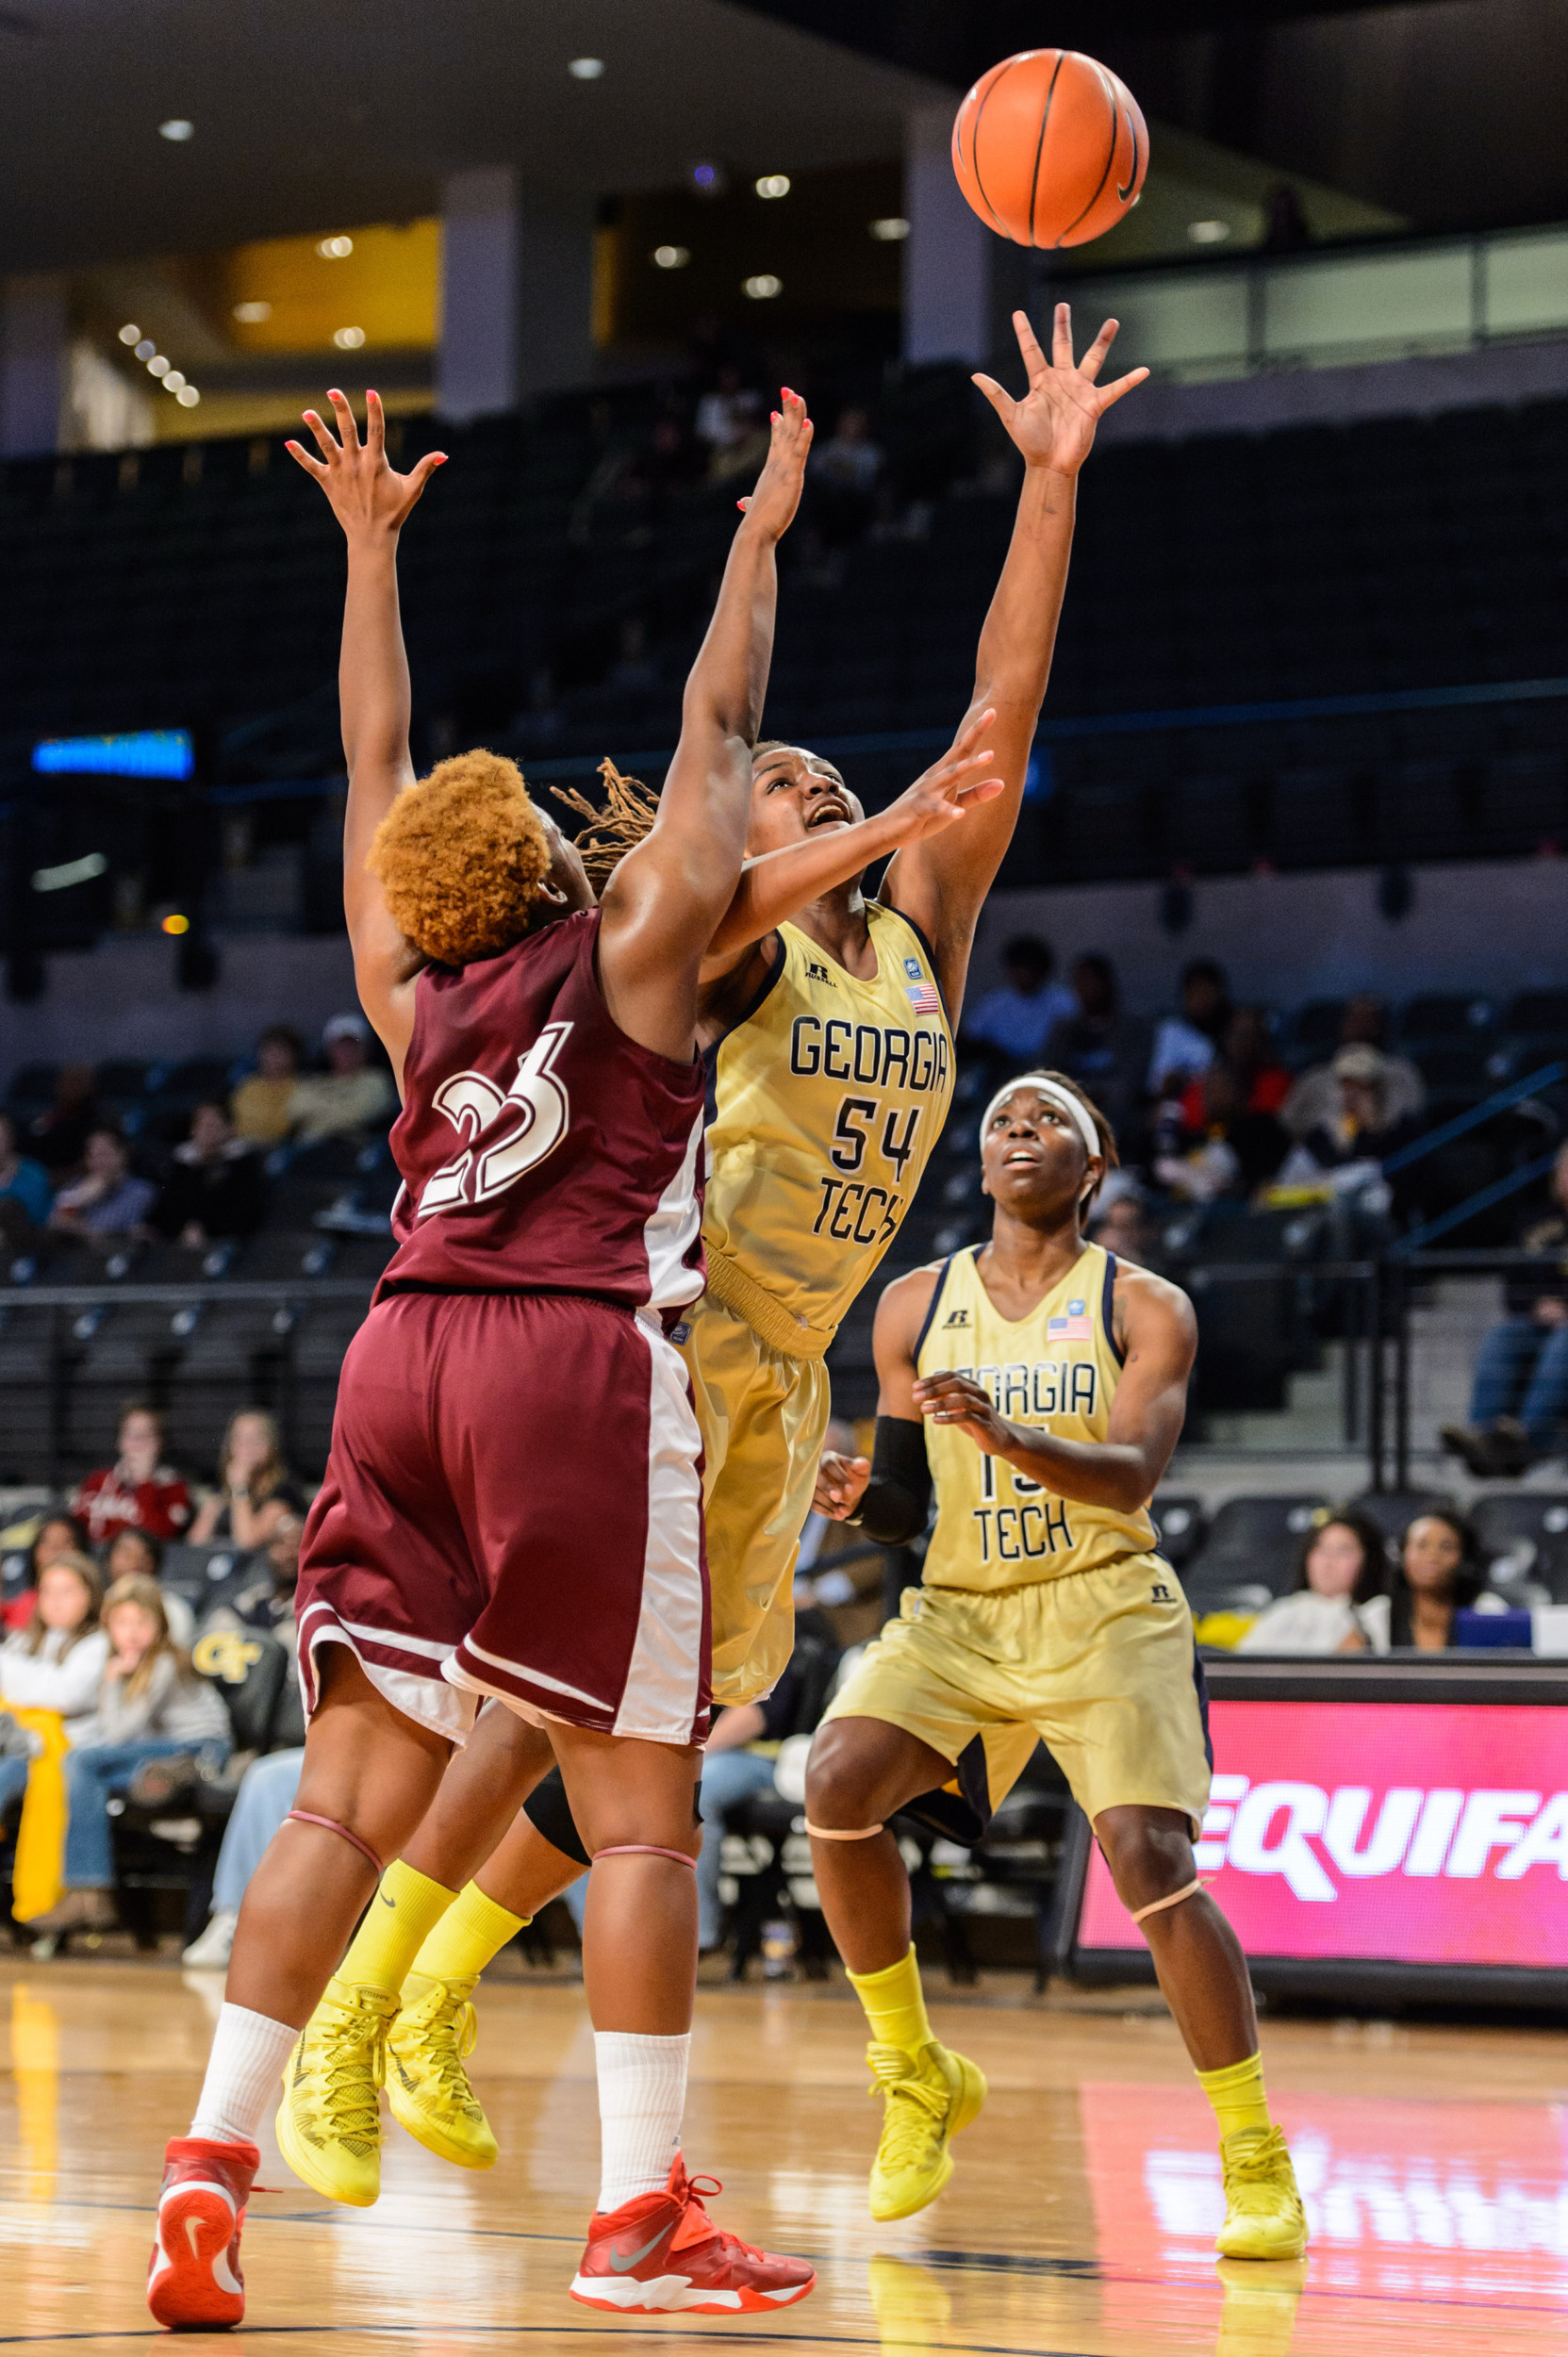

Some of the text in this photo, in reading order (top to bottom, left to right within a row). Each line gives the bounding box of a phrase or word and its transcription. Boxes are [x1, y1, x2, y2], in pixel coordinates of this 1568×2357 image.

[804, 971, 838, 989] RUSSELL
[790, 1014, 948, 1094] GEORGIA
[830, 1094, 923, 1186] 54
[933, 1360, 1098, 1417] ORGIA
[973, 1498, 1077, 1564] TECH
